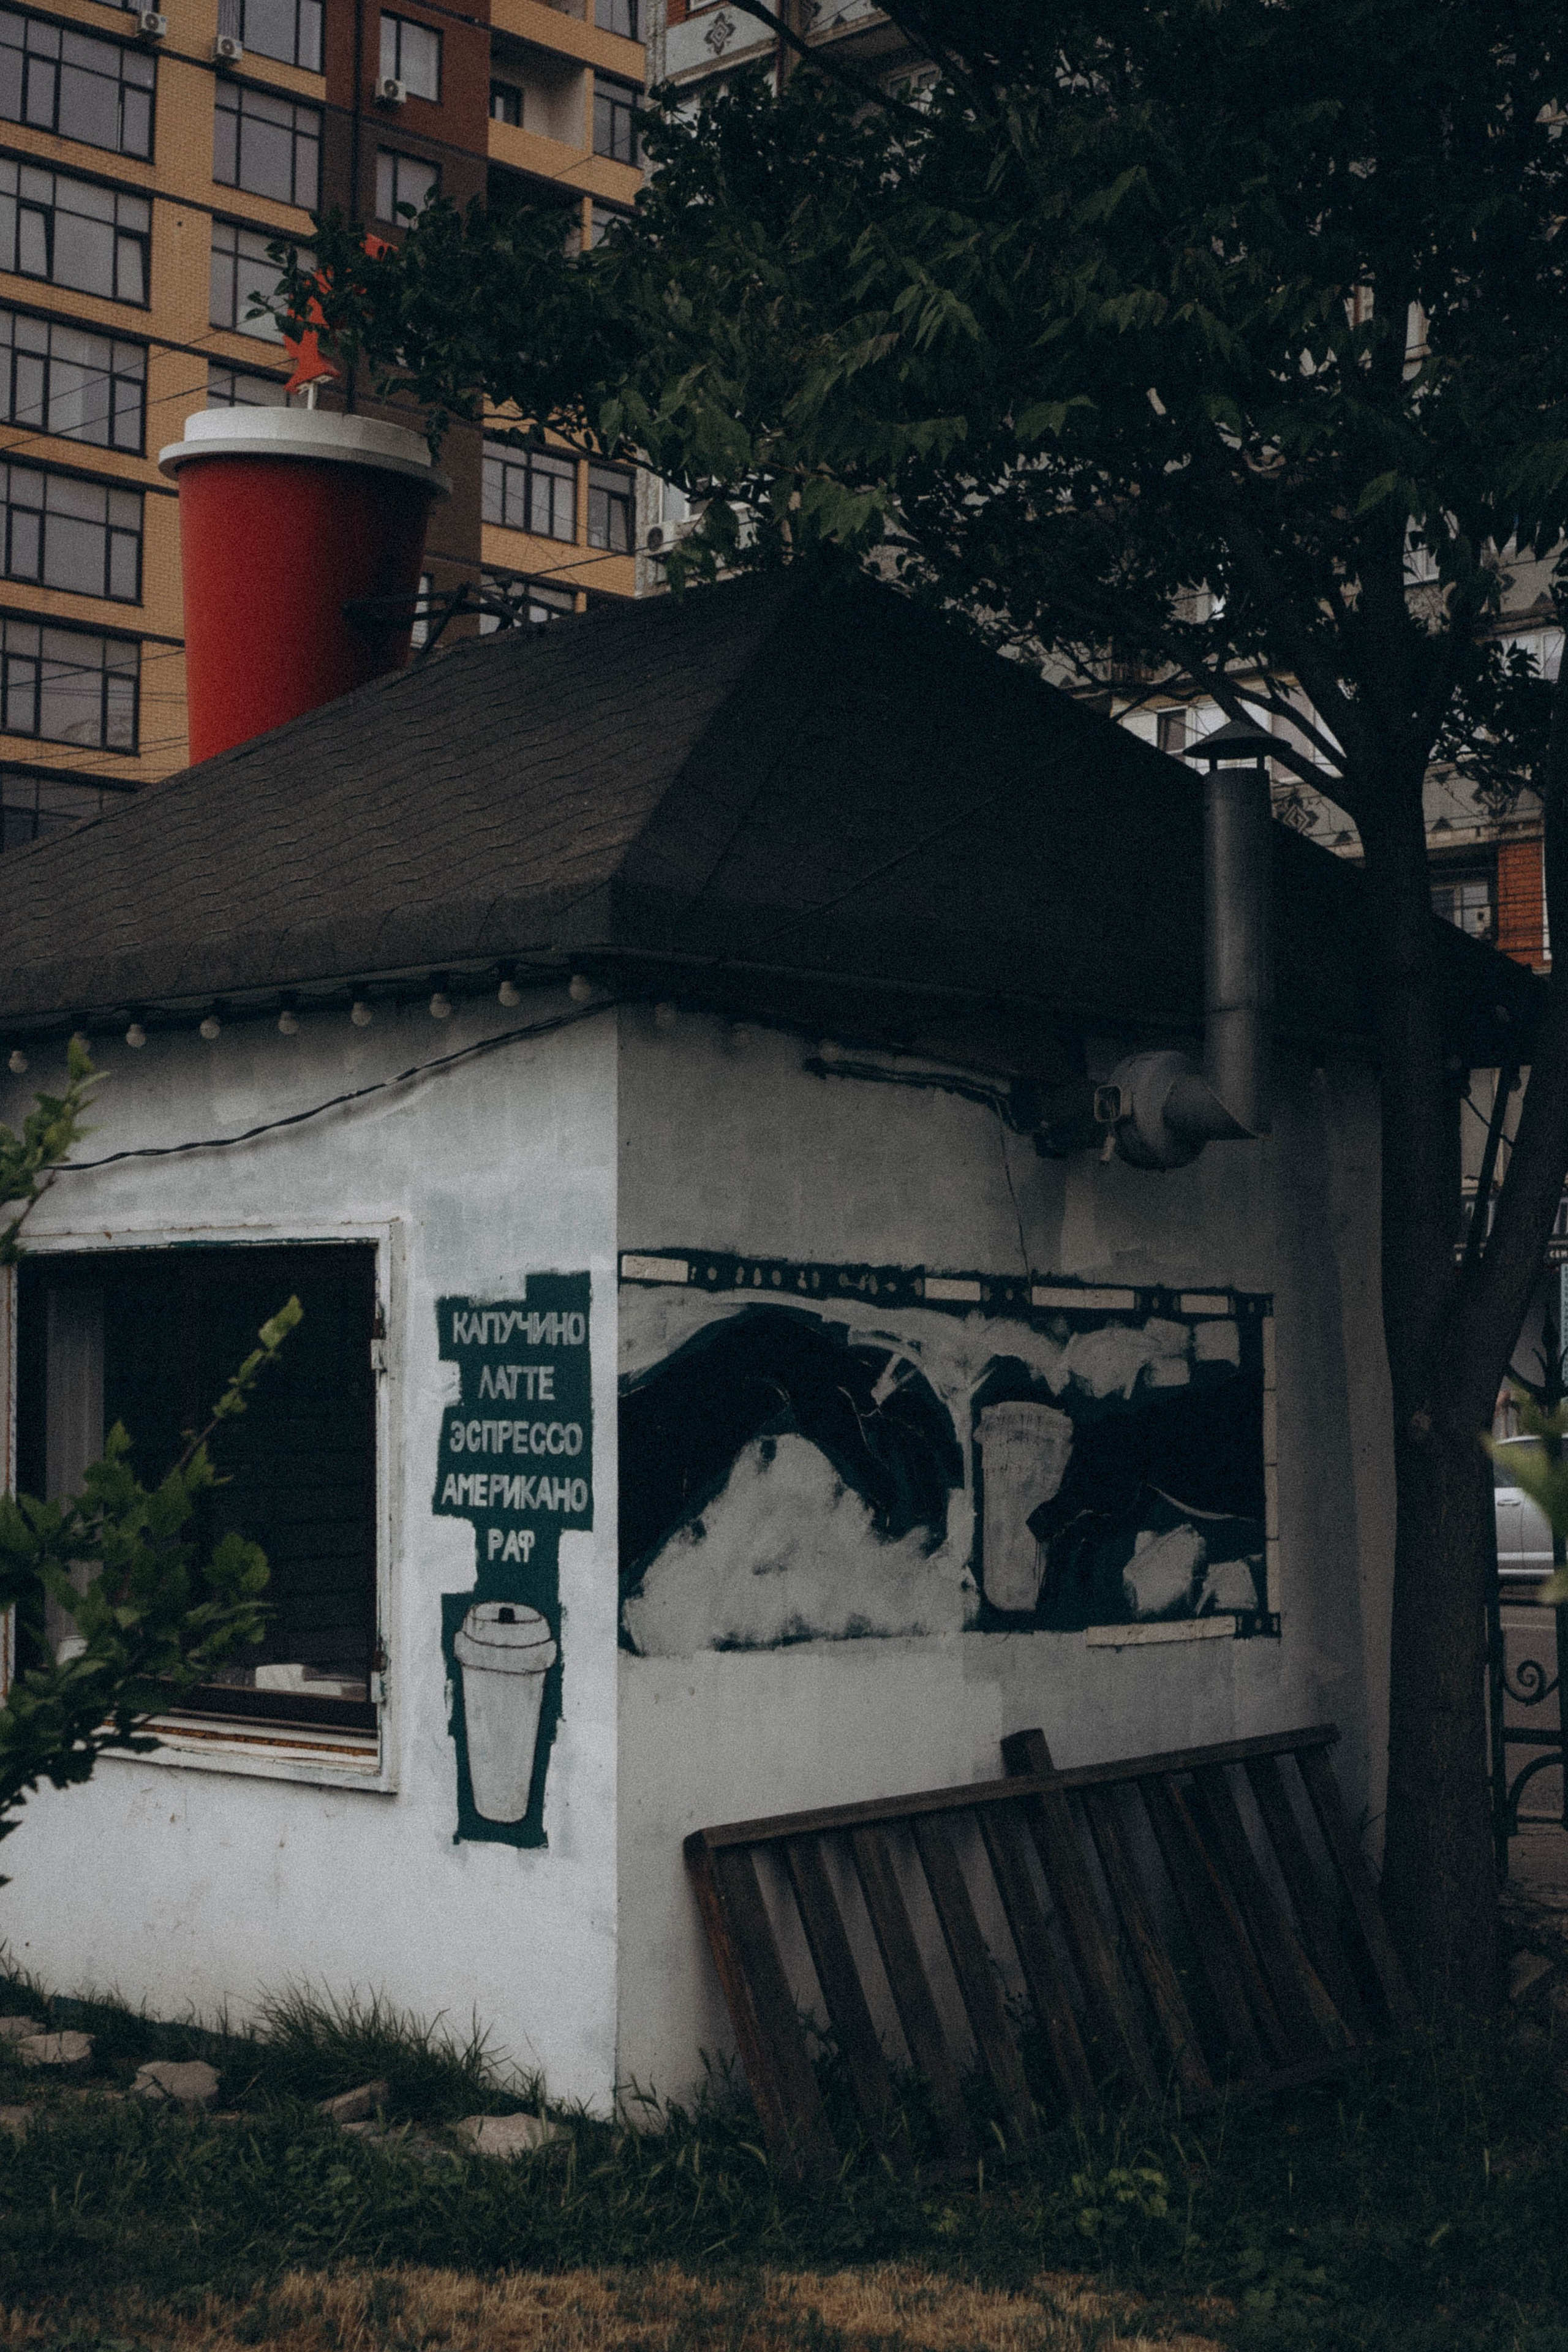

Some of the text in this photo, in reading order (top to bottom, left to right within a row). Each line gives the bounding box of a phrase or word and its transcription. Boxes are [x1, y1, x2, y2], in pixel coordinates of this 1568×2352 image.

[453, 1311, 586, 1345] КАПУЧИНО
[478, 1365, 555, 1400] ЛАТТЕ
[450, 1420, 582, 1455] ЭСПРЕССО
[441, 1473, 588, 1512] АМЕРИКАНО
[488, 1529, 535, 1562] РАФ
